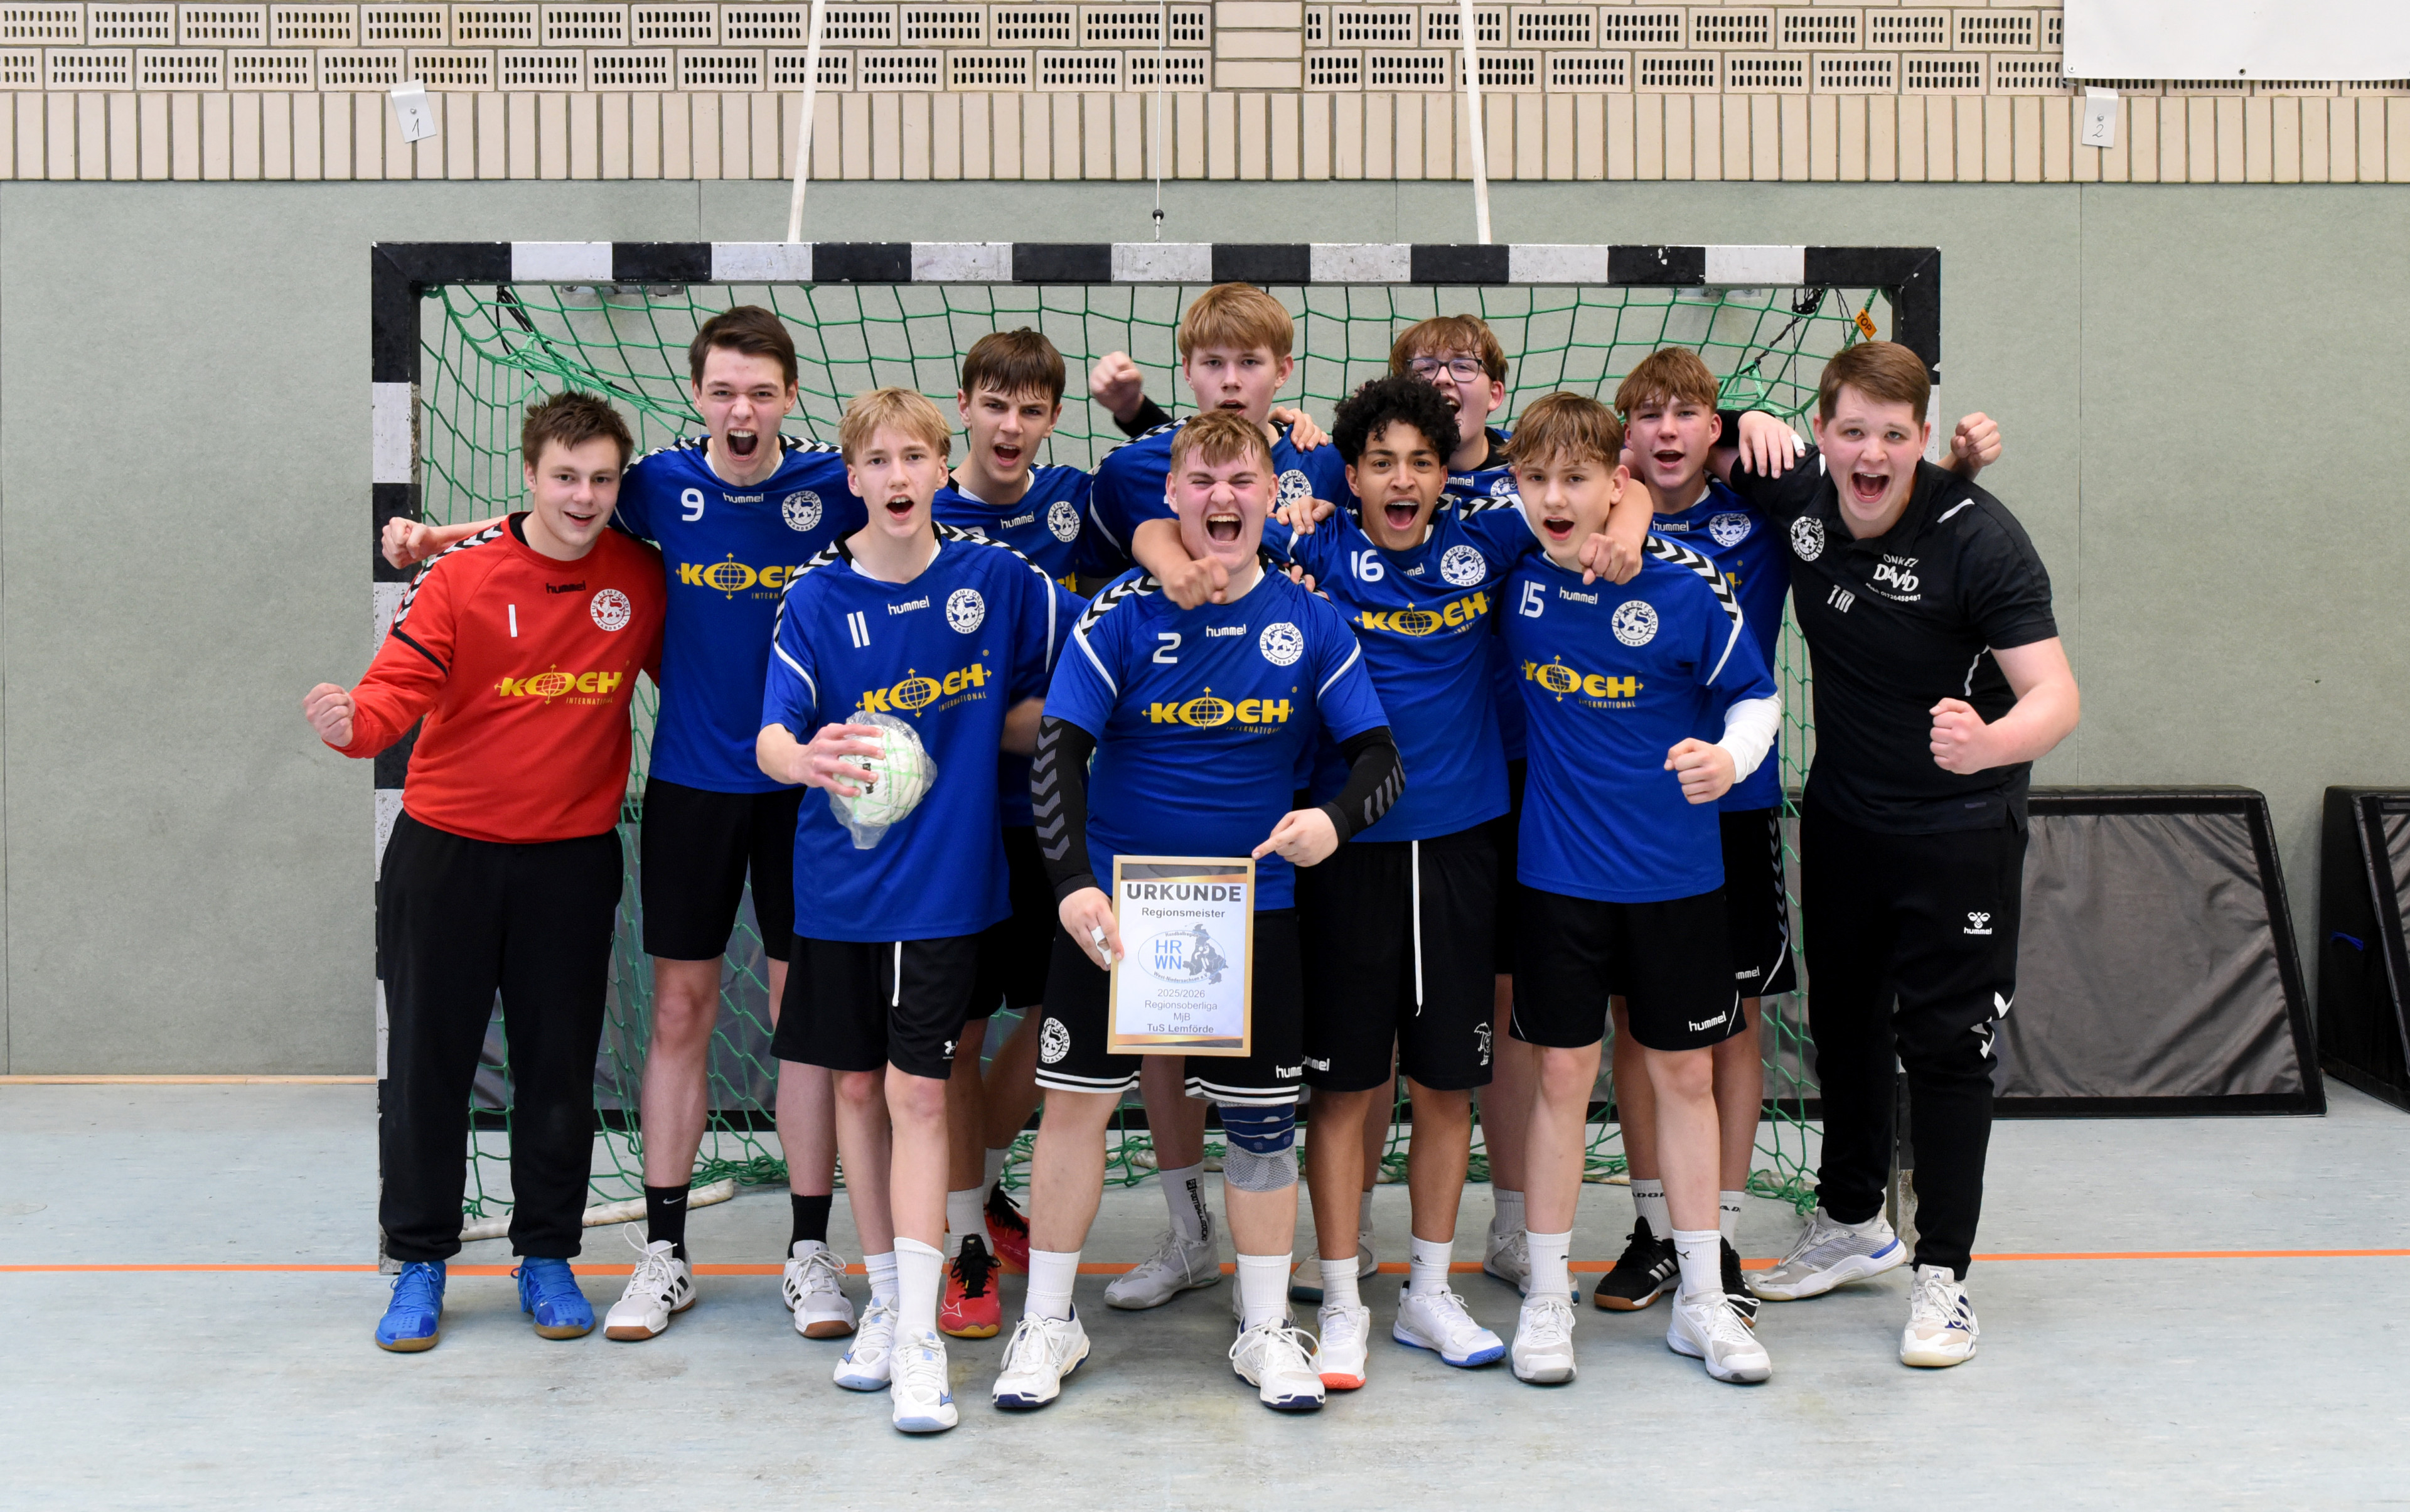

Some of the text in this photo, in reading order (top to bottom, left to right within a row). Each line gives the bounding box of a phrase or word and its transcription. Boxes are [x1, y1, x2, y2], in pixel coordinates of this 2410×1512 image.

[412, 118, 419, 137] 1
[2092, 124, 2104, 137] 2
[1857, 311, 1872, 331] TOP
[1445, 475, 1474, 487] ummel
[681, 488, 705, 522] 9
[722, 492, 764, 503] hummel
[788, 518, 818, 530] HANDBALL
[1000, 510, 1035, 530] hummel
[1652, 520, 1689, 532] hummel
[1351, 549, 1384, 582] 16
[545, 580, 586, 594] hummel
[1873, 563, 1919, 592] DAVID
[1519, 580, 1546, 618] 15
[1559, 586, 1598, 605] hummel
[887, 595, 929, 616] hummel
[1361, 591, 1488, 636] KOCH
[508, 604, 518, 637] 1
[847, 611, 870, 648] 11
[1206, 623, 1246, 637] hummel
[1152, 633, 1182, 663] 2
[1265, 653, 1299, 665] HANDBALL
[500, 672, 622, 697] KOCH
[863, 663, 985, 713] KOCH
[939, 691, 987, 712] INTERNATIONAL
[1150, 697, 1289, 727] KOCH
[1127, 883, 1241, 902] URKUNDE
[1142, 907, 1226, 918] Regionsmeister
[1155, 940, 1182, 954] HR
[1155, 955, 1182, 970] WN
[1154, 971, 1200, 983] West-Niedersachsen
[1157, 989, 1205, 998] 2025/2026
[1145, 1000, 1218, 1012] Regionsoberliga
[1174, 1012, 1191, 1022] MjB
[1688, 1011, 1727, 1032] hummel
[1147, 1024, 1214, 1033] TuS Lemförde
